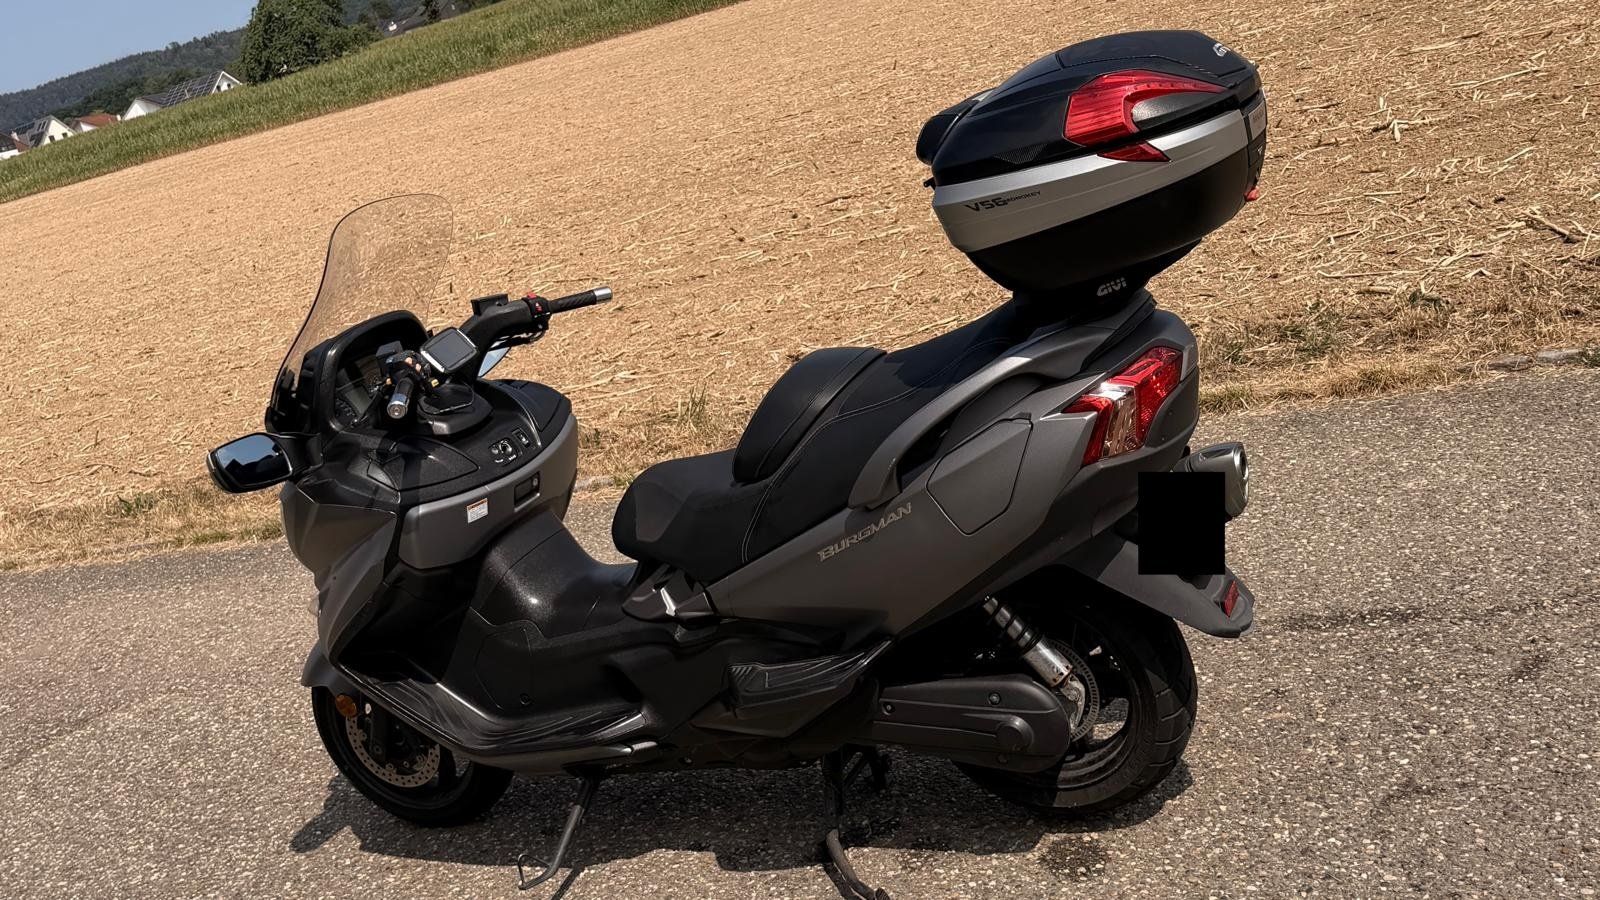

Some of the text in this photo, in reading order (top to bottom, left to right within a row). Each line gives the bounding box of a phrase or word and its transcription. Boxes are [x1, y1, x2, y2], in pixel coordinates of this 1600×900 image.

[964, 197, 1008, 211] V56
[1096, 277, 1127, 297] GIVI
[817, 502, 912, 562] BURGMAN
